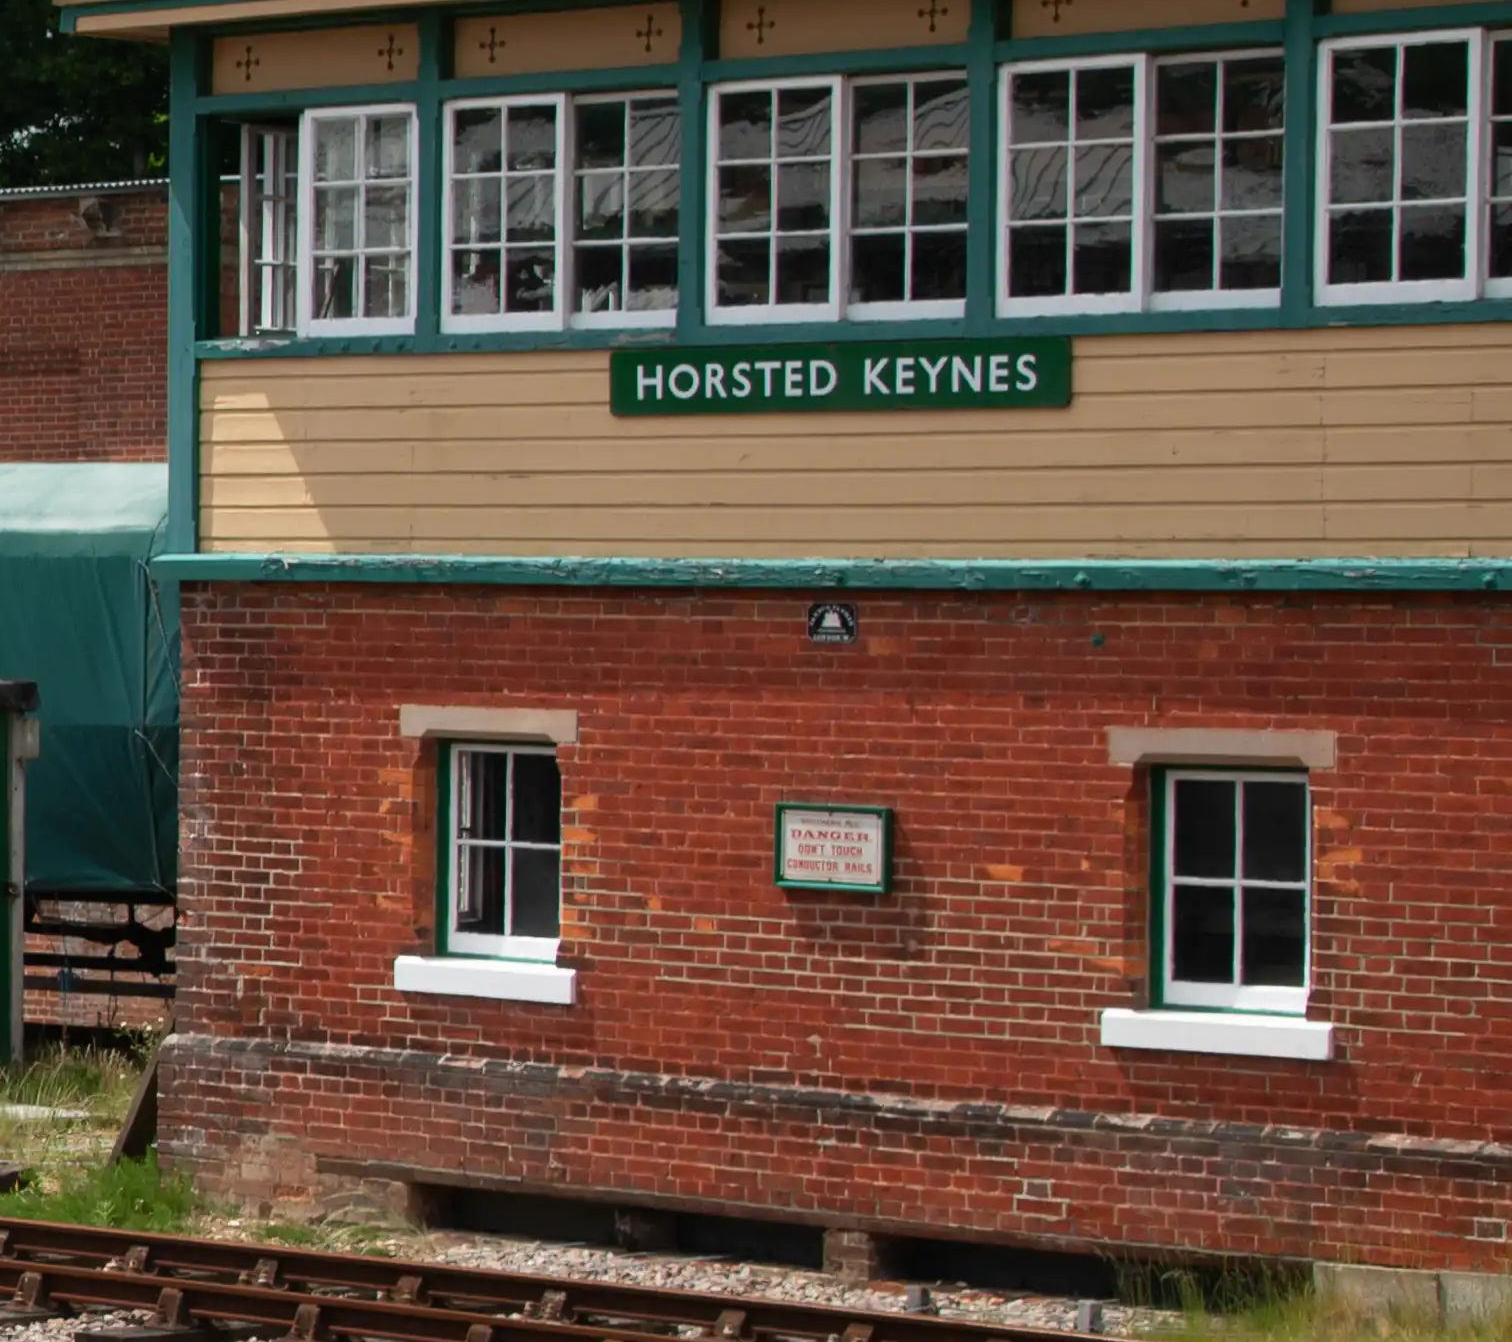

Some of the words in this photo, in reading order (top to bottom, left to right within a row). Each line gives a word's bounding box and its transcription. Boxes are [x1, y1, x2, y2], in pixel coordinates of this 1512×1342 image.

[636, 360, 839, 401] HORSTED
[863, 354, 1039, 396] KEYNES
[831, 845, 863, 857] TOUCH
[787, 859, 838, 872] CONDUCTOR
[844, 862, 873, 874] RAILS
